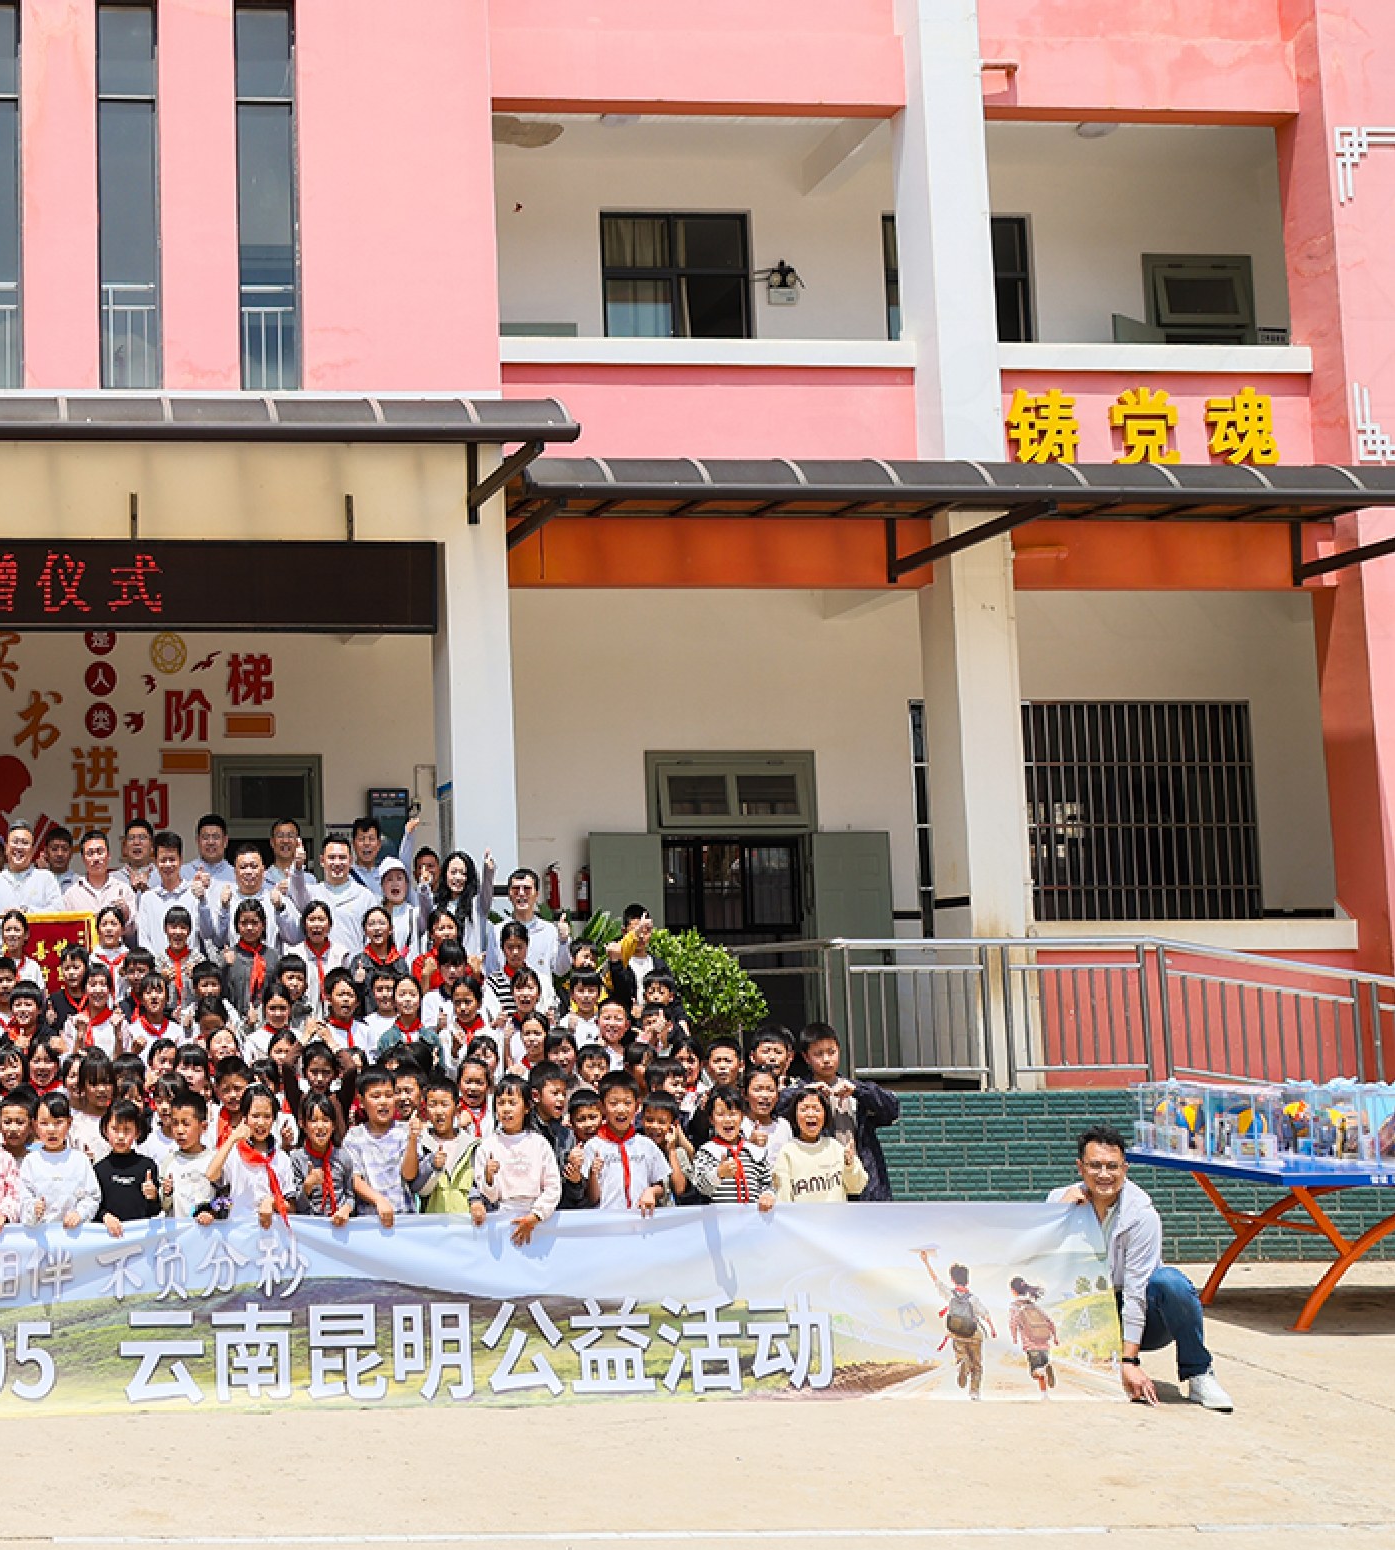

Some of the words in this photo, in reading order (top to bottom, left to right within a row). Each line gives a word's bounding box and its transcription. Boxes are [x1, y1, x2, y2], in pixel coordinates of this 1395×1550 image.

[1004, 386, 1280, 466] 铸党魂
[96, 1231, 309, 1302] 不负分秒
[119, 1291, 836, 1404] 云南昆明公益活动
